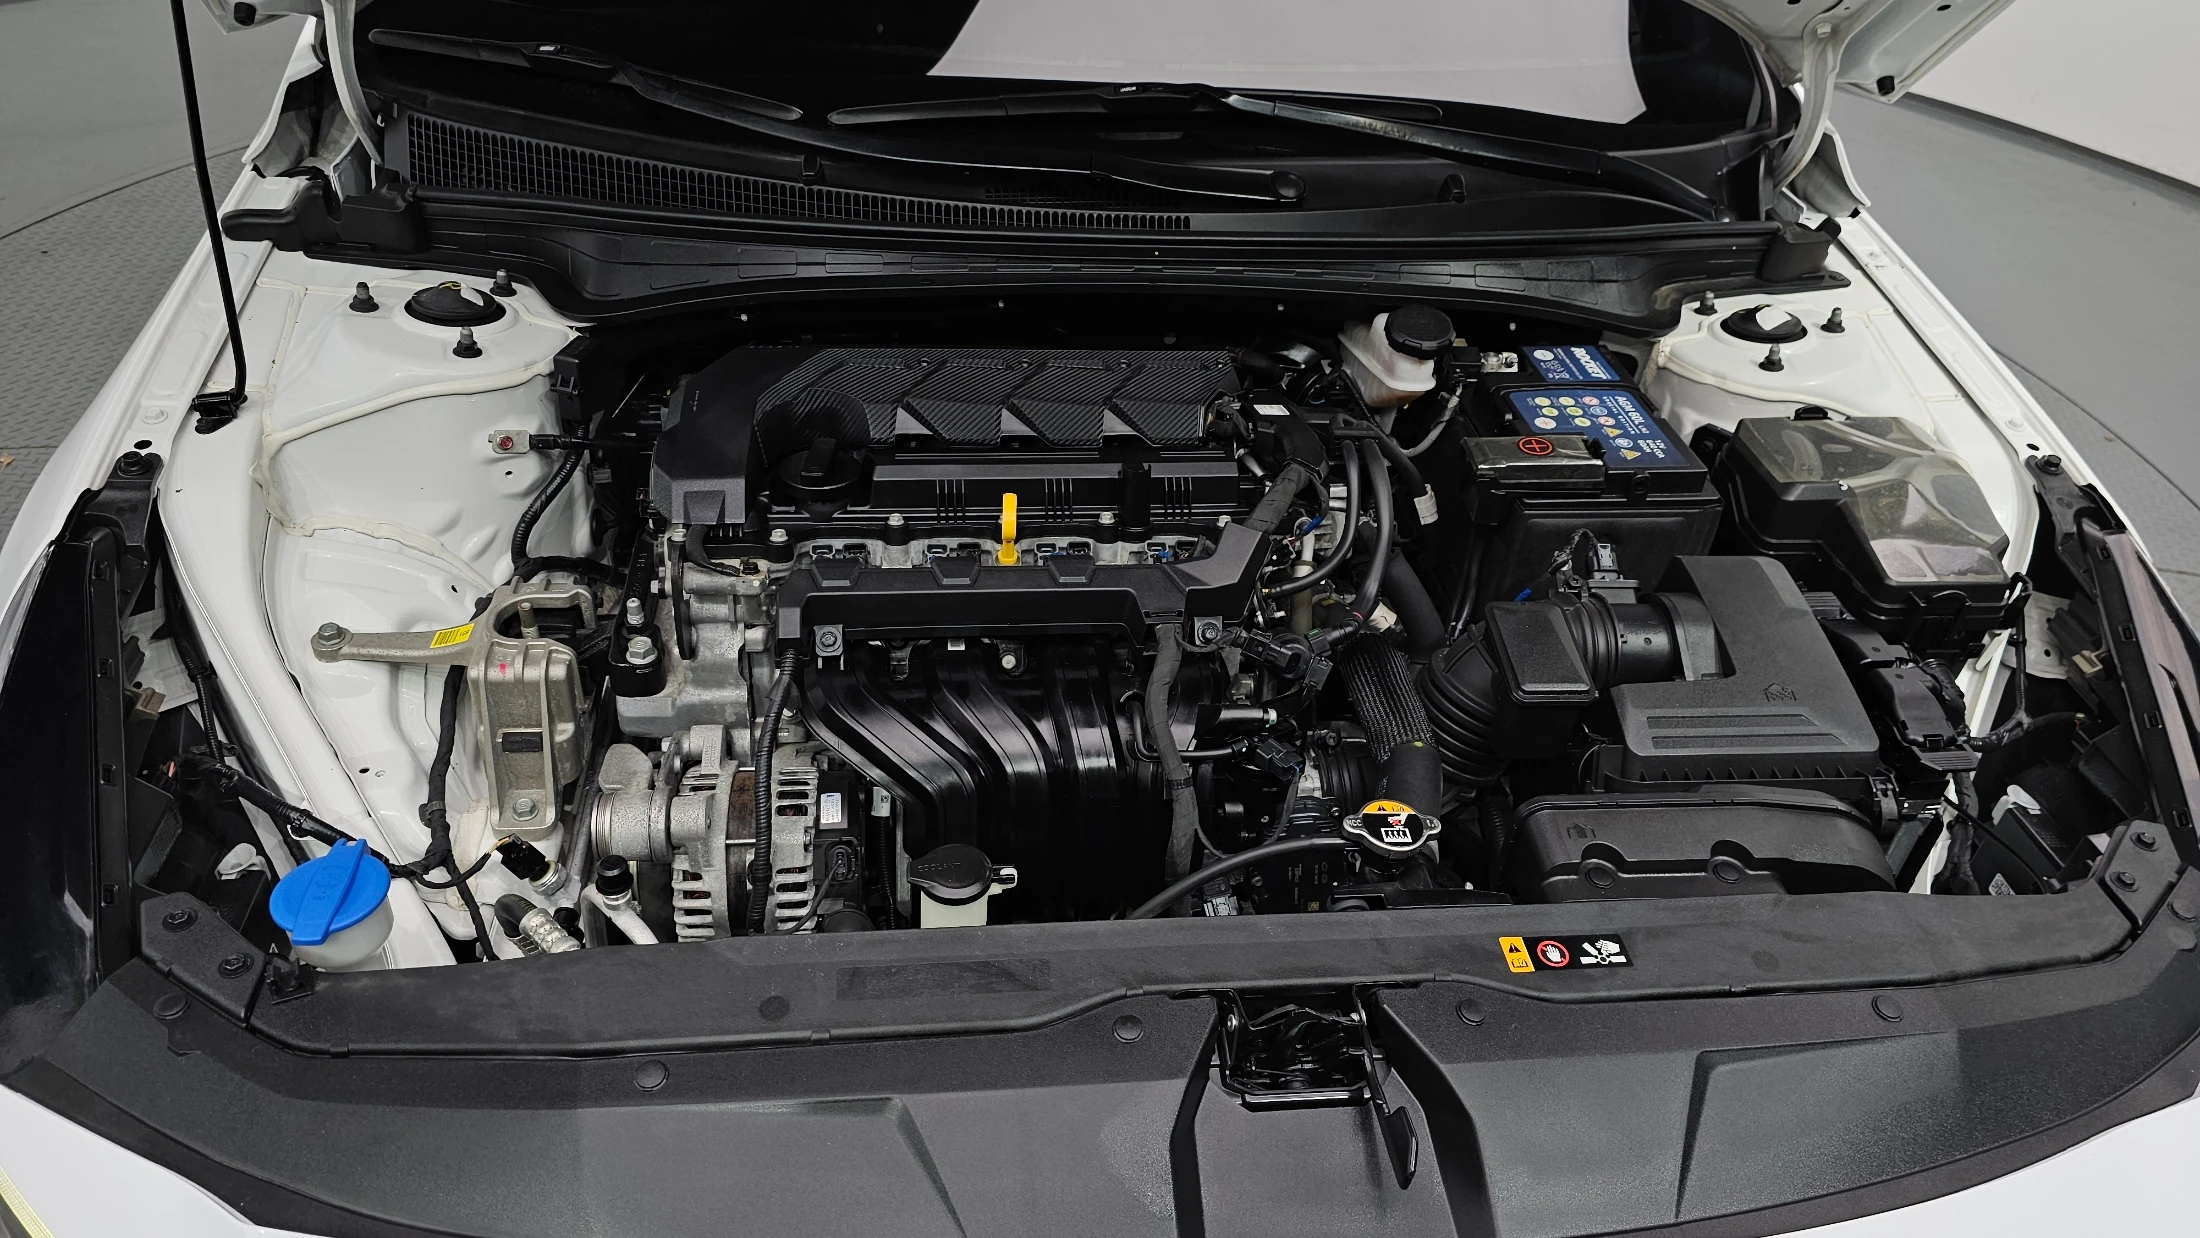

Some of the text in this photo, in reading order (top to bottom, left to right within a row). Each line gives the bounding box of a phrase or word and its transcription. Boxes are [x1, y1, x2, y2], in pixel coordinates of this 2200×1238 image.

[1570, 347, 1607, 379] ROCKET
[1602, 396, 1619, 413] SPECIAL
[1618, 415, 1635, 434] EDITION
[1615, 396, 1635, 412] AGM
[1627, 412, 1645, 425] 60L
[917, 861, 961, 872] COOLANT
